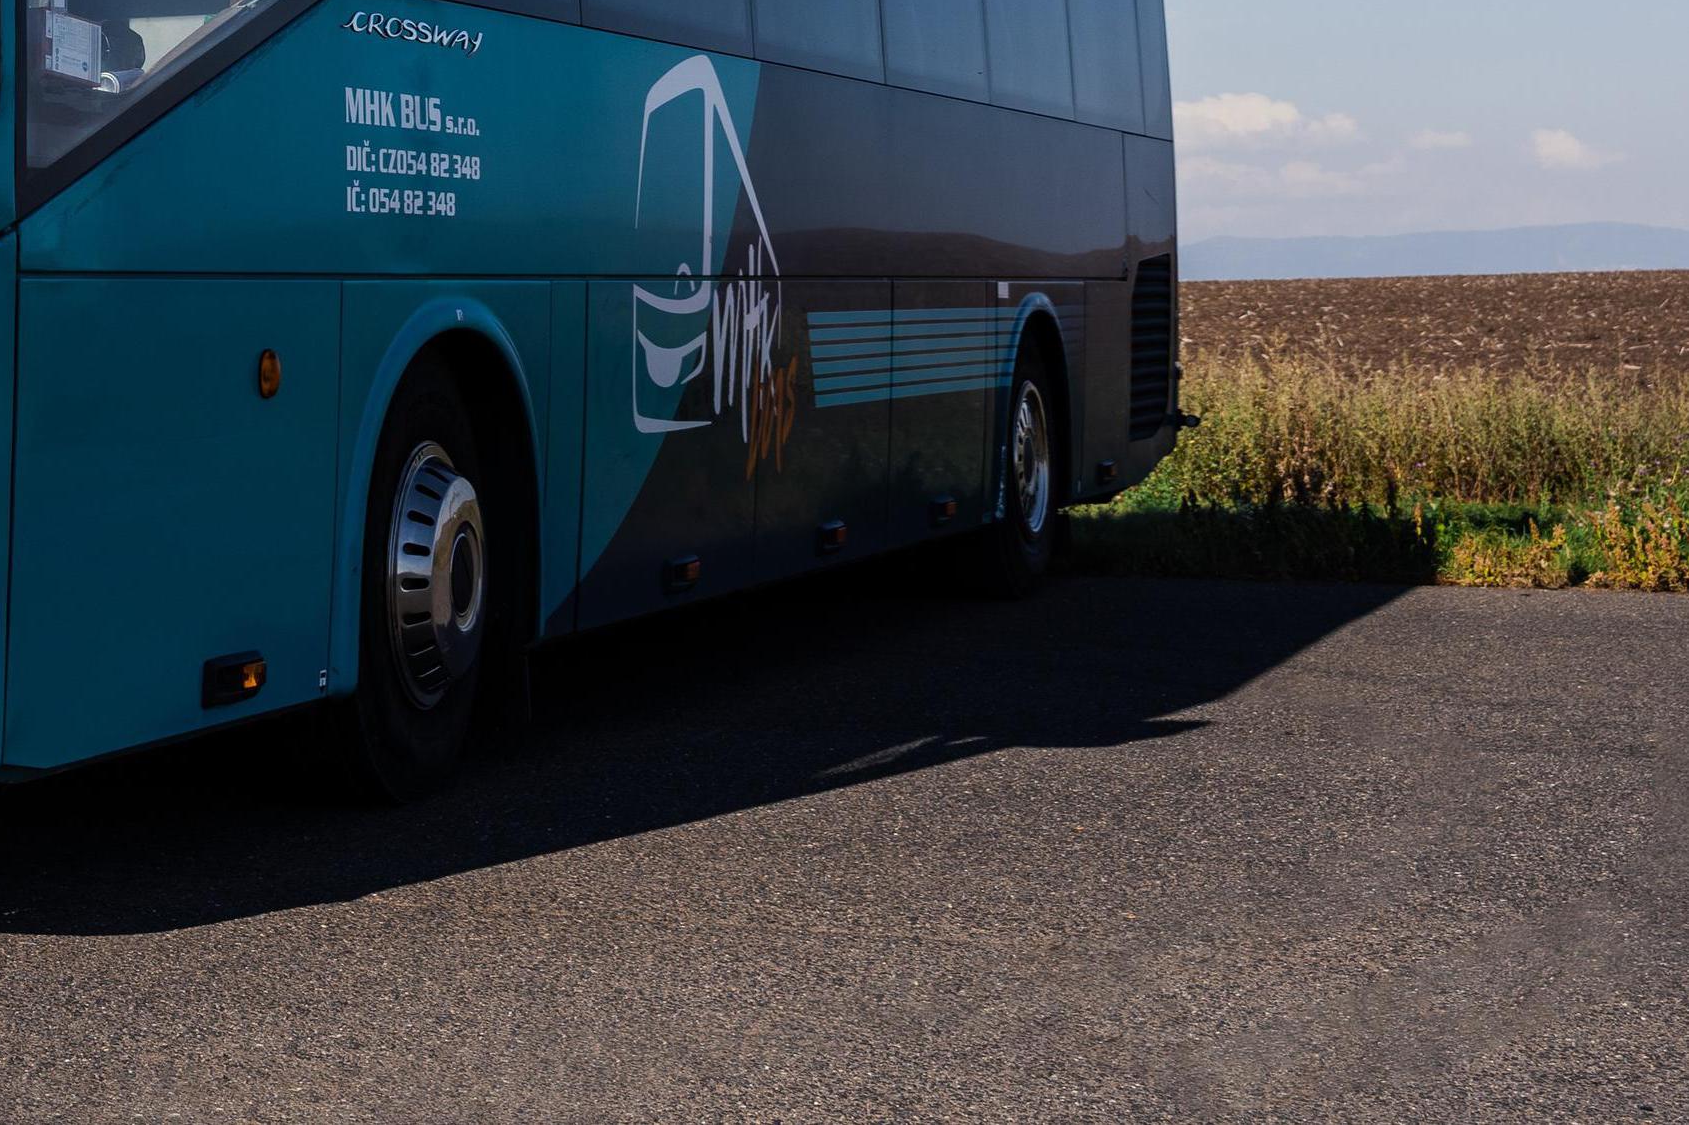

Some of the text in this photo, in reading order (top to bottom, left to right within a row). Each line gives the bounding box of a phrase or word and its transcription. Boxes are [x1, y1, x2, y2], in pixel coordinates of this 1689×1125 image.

[343, 11, 484, 56] CROSSWAY
[345, 86, 480, 137] MHK BUS s.r.o.
[346, 139, 481, 180] DIČ: CZ054 82 348
[346, 179, 456, 217] IČ: 054 82 348
